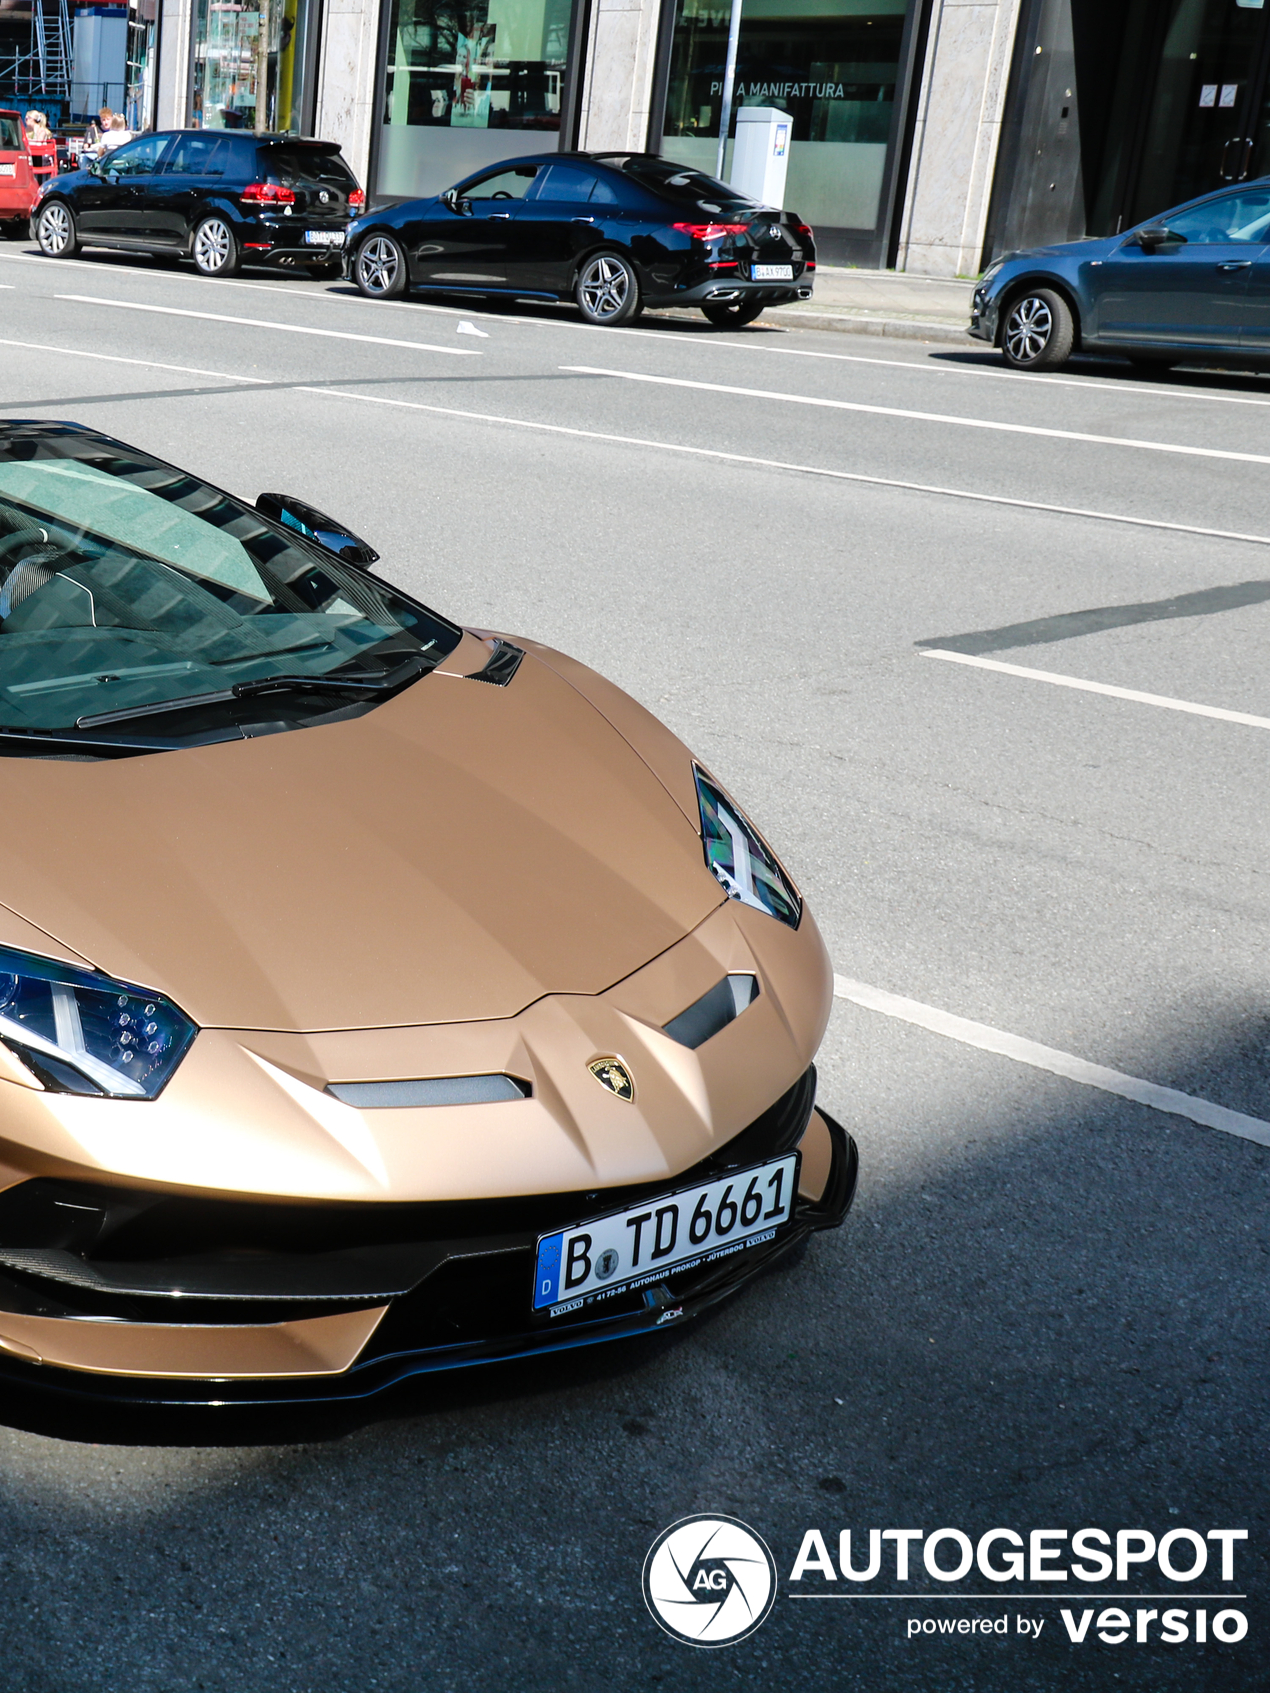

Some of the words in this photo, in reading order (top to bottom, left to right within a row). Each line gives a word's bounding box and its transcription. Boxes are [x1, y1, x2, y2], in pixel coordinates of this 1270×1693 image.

[749, 82, 844, 98] MANIFATTURA
[564, 1232, 593, 1291] B
[626, 1203, 679, 1268] TD
[688, 1167, 785, 1246] 6661
[541, 1279, 552, 1296] D
[552, 1300, 583, 1316] VOLVO
[629, 1270, 670, 1290] AUTOHAUS
[671, 1259, 701, 1276] PROKOP
[706, 1243, 744, 1262] JÜTERBOG
[747, 1231, 775, 1247] VOLVO
